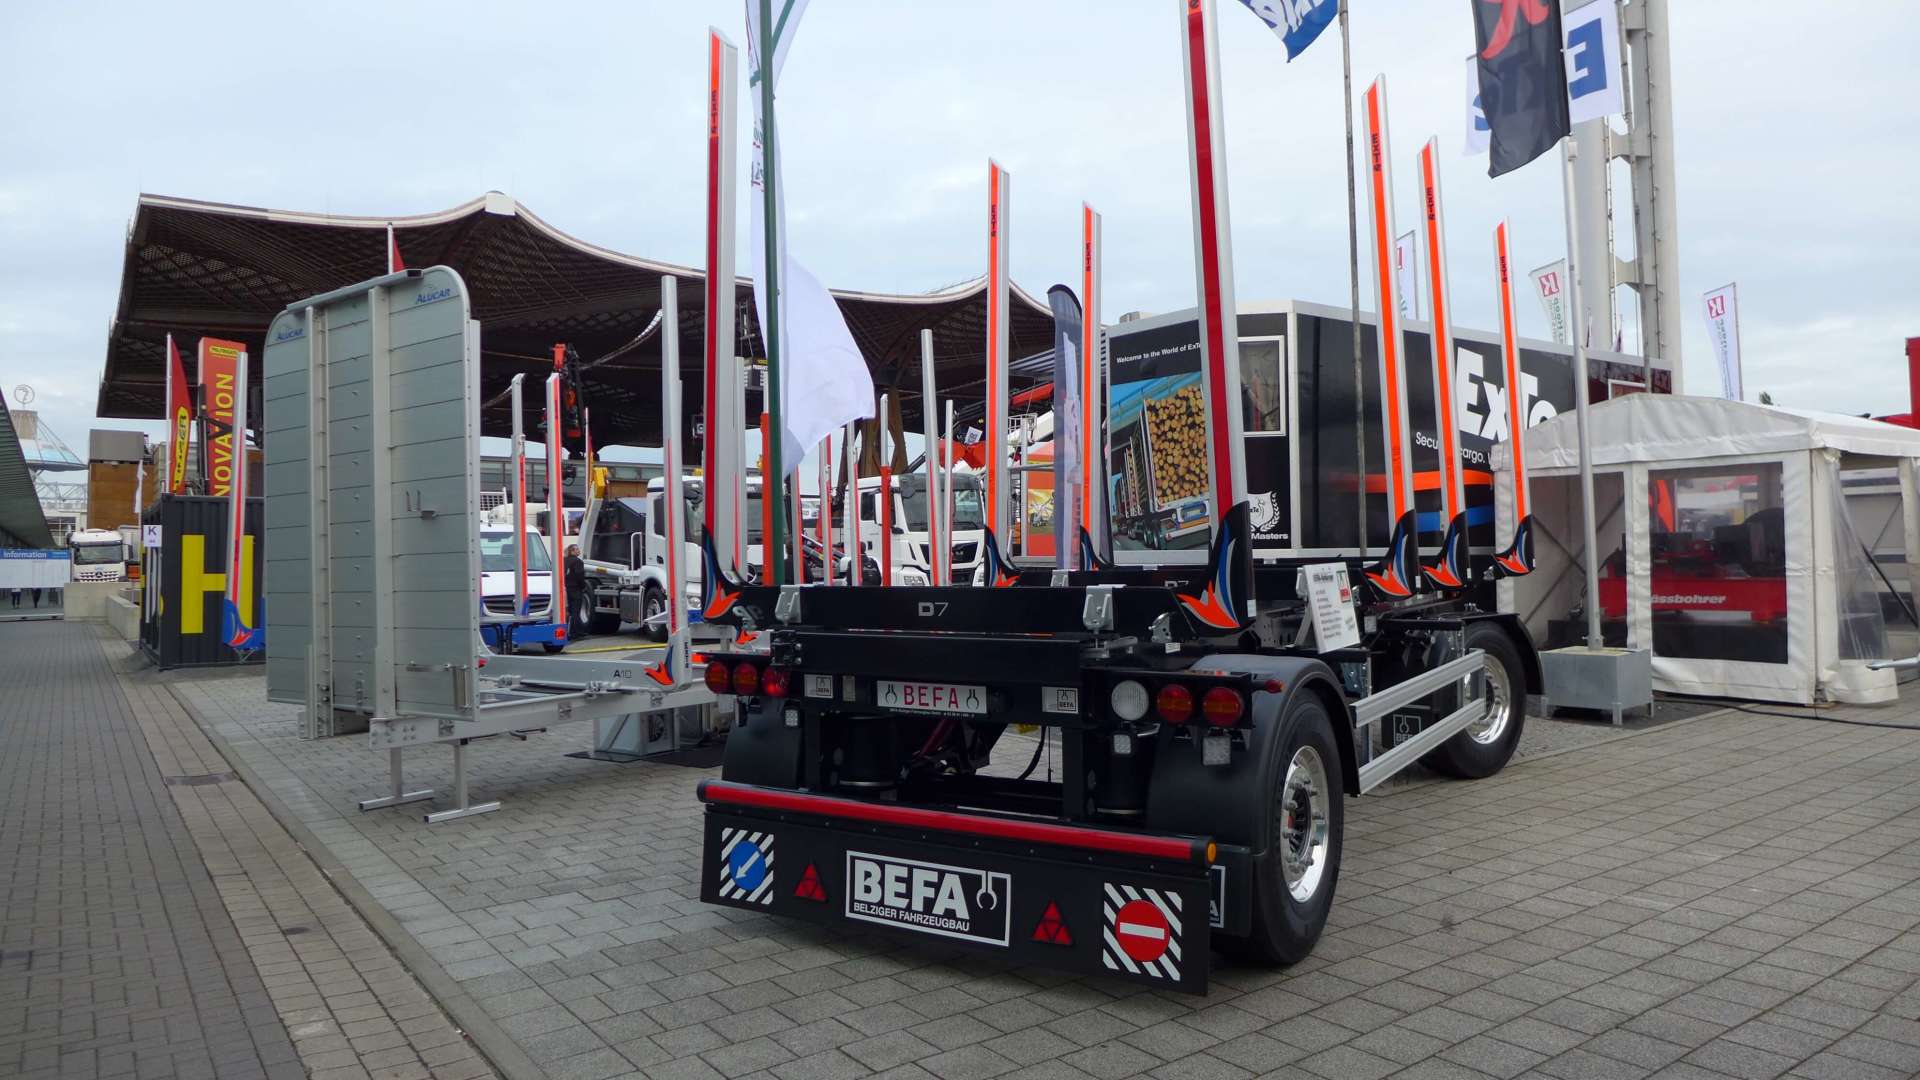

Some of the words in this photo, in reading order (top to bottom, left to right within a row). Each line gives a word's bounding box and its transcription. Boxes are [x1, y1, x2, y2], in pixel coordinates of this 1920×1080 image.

[1117, 353, 1141, 364] Welcome
[1161, 347, 1178, 356] World
[148, 526, 157, 536] K
[918, 602, 949, 617] D7
[903, 684, 960, 710] BEFA
[854, 859, 970, 920] BEFA
[853, 902, 897, 919] BELZIGER
[898, 910, 970, 932] FAHRZEUGBAU
